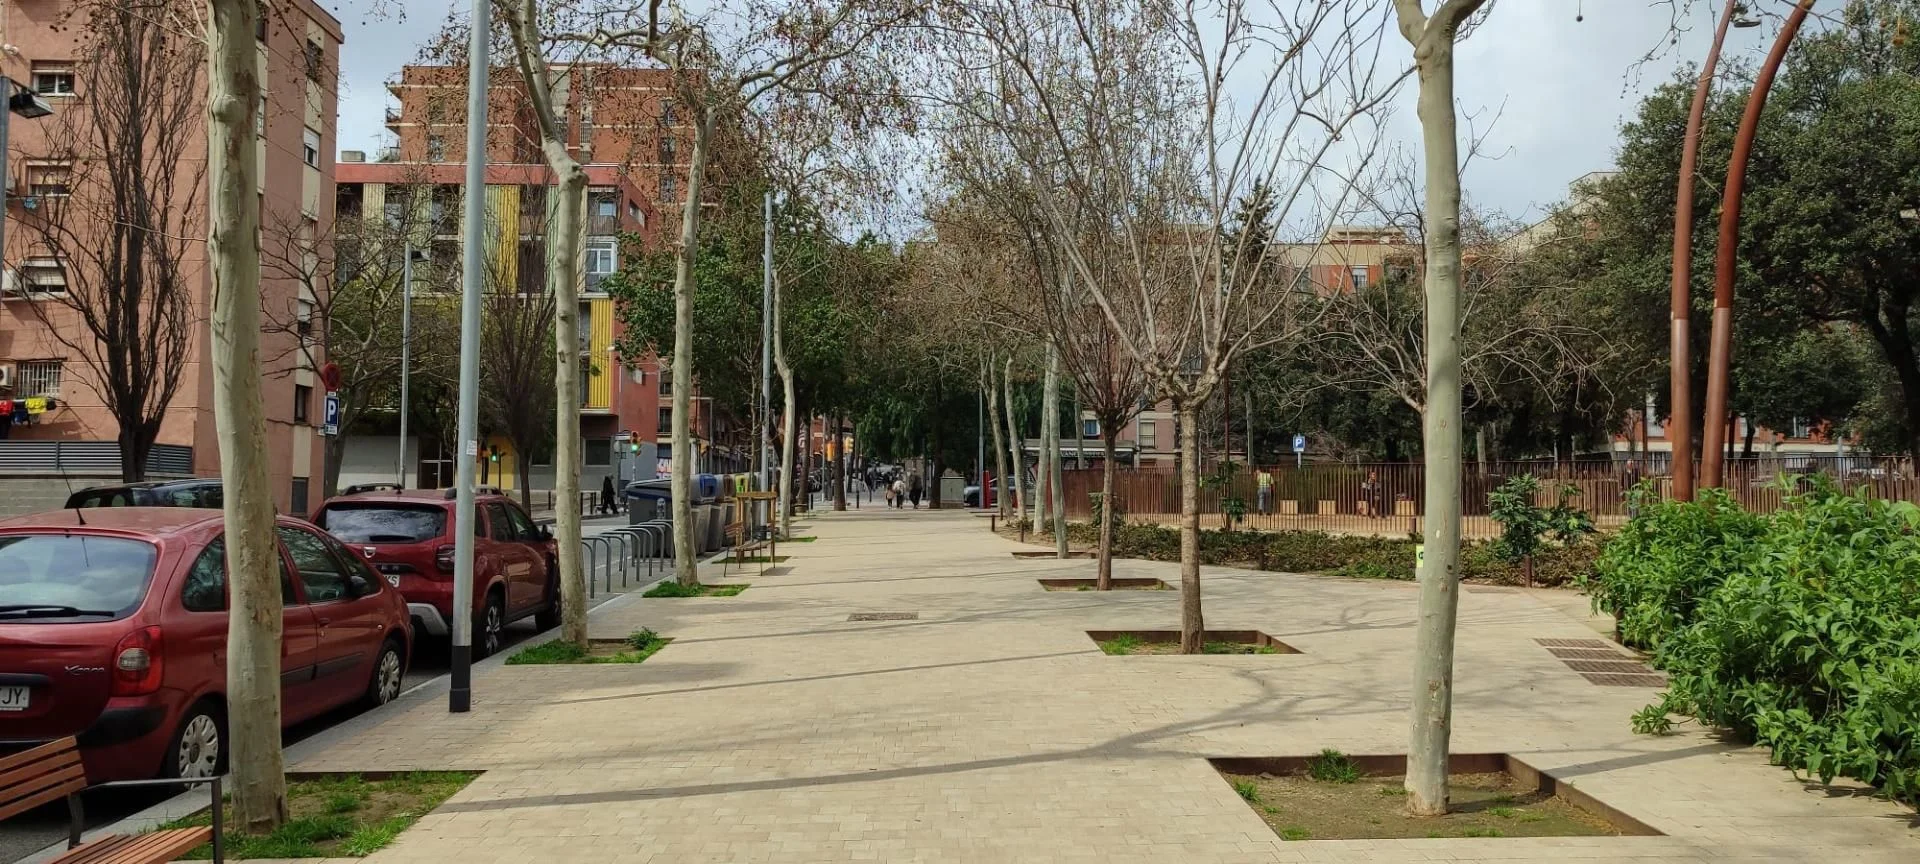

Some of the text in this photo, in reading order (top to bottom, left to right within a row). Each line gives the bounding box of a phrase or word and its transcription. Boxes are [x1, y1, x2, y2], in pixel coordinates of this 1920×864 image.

[328, 400, 337, 422] P
[1296, 438, 1302, 447] P
[0, 688, 23, 705] JY
